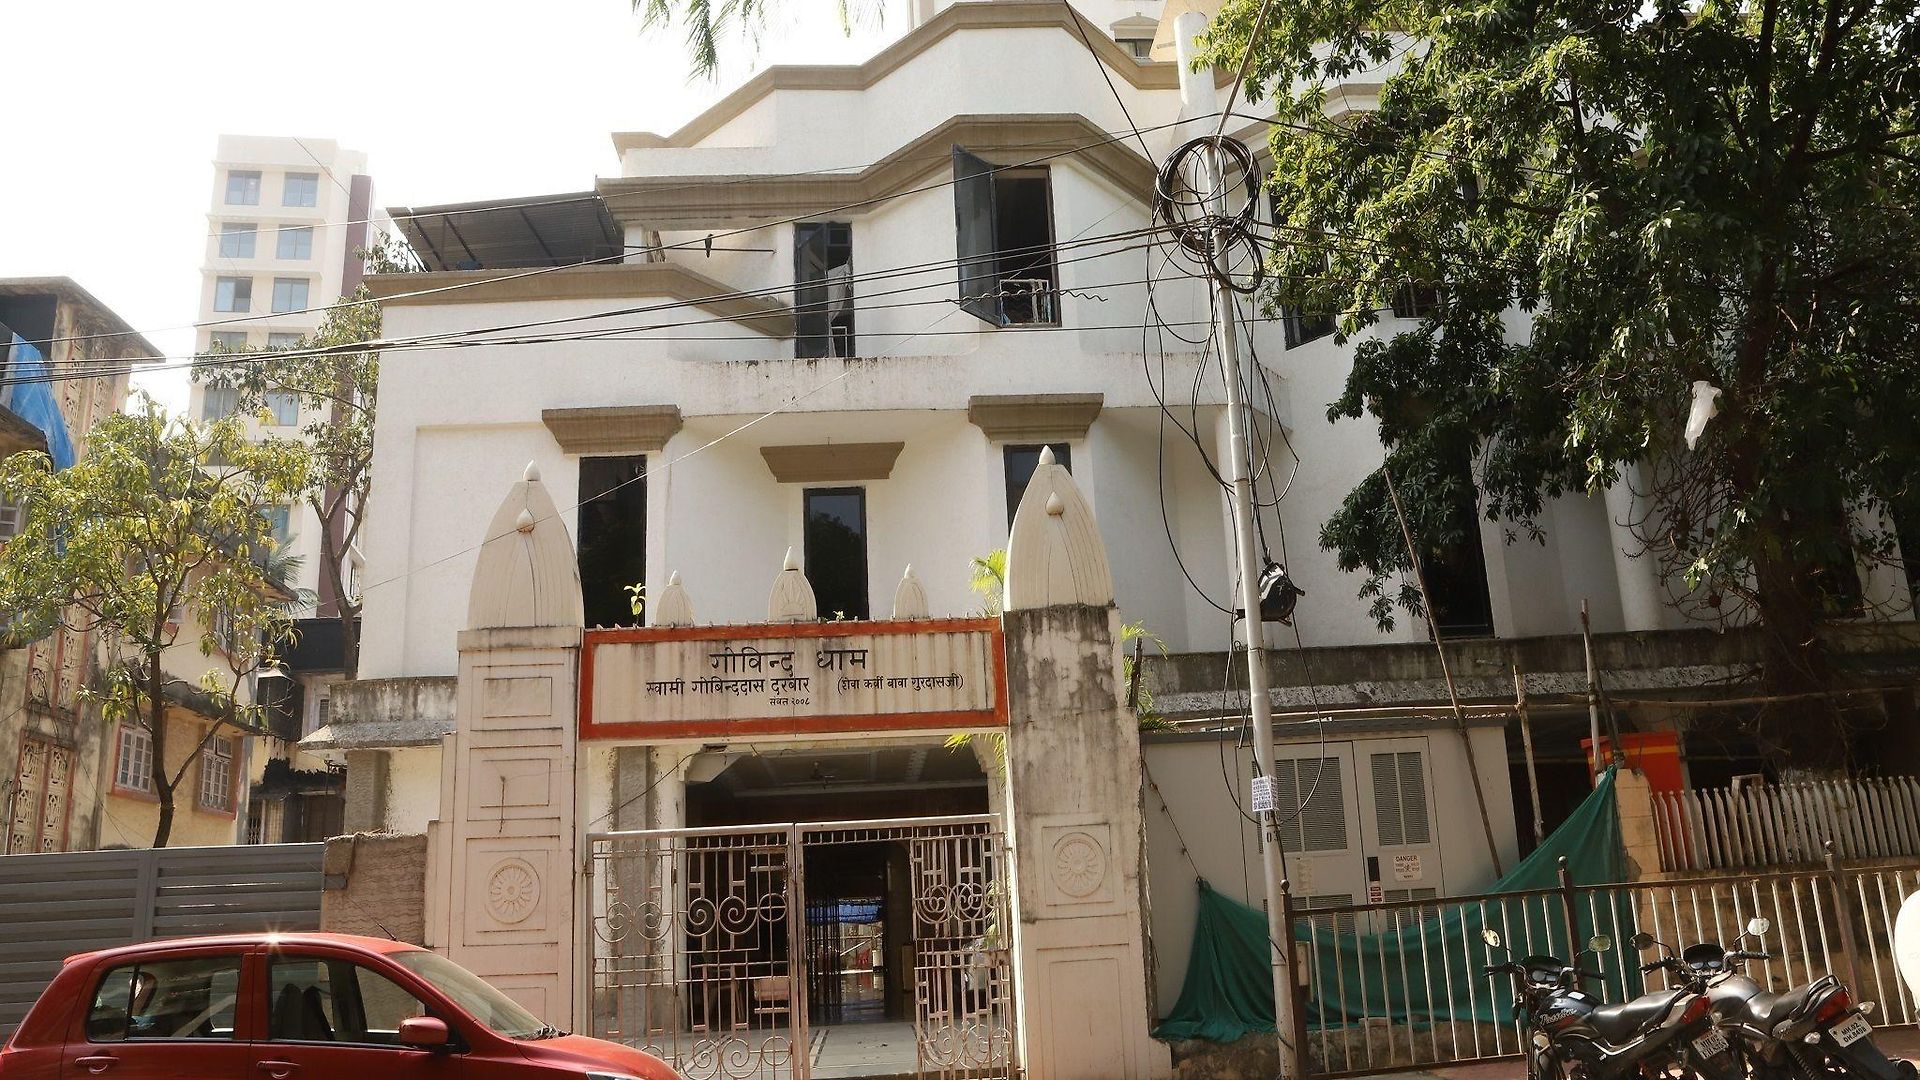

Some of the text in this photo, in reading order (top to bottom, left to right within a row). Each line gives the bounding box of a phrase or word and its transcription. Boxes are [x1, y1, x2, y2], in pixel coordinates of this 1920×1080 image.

[709, 646, 868, 677] गोविन्द धाम
[646, 676, 810, 696] स्वामी गोबिन्ददास दरबार
[791, 697, 810, 706] २००८
[1395, 854, 1418, 862] DANGER
